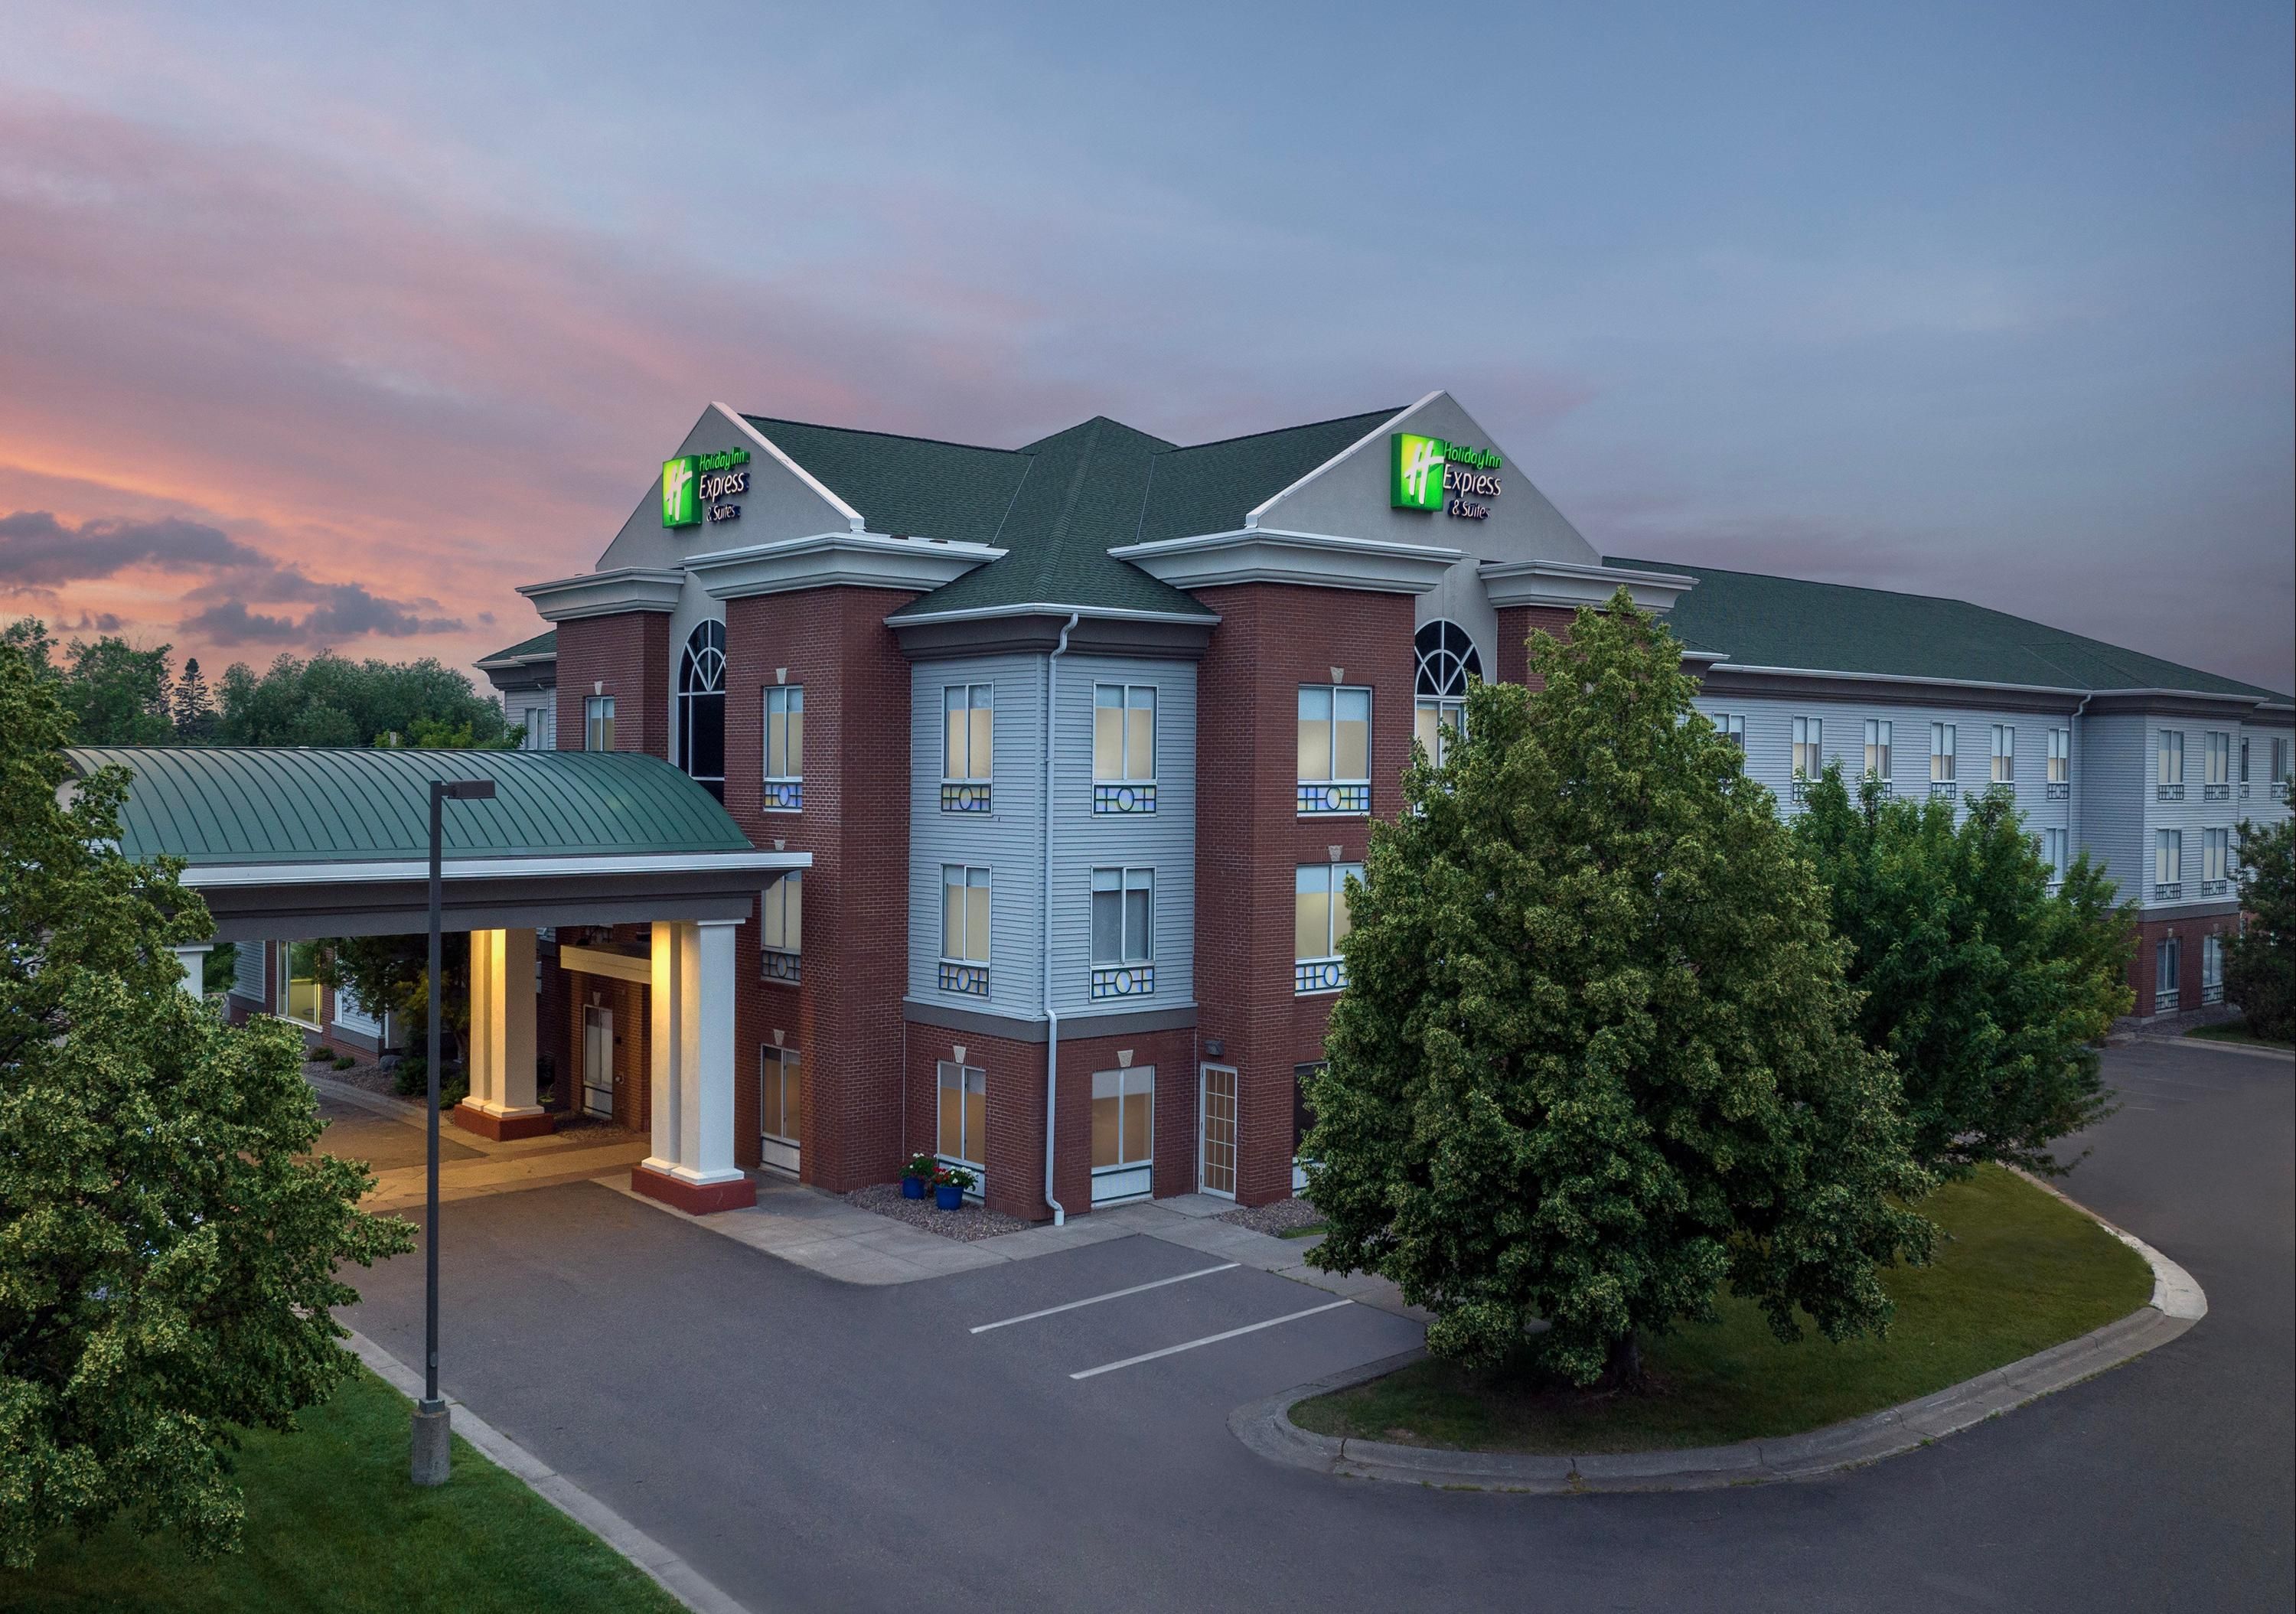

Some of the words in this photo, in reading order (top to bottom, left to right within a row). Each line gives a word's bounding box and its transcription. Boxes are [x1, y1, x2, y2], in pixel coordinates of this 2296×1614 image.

[700, 450, 731, 471] Holiday
[731, 447, 745, 465] Inn
[1443, 441, 1485, 469] Holiday
[1485, 448, 1502, 468] Inn
[699, 472, 745, 502] Express
[1443, 463, 1502, 497] Express
[713, 504, 735, 520] Suites
[1452, 499, 1459, 515] &
[1461, 501, 1490, 519] Suites
